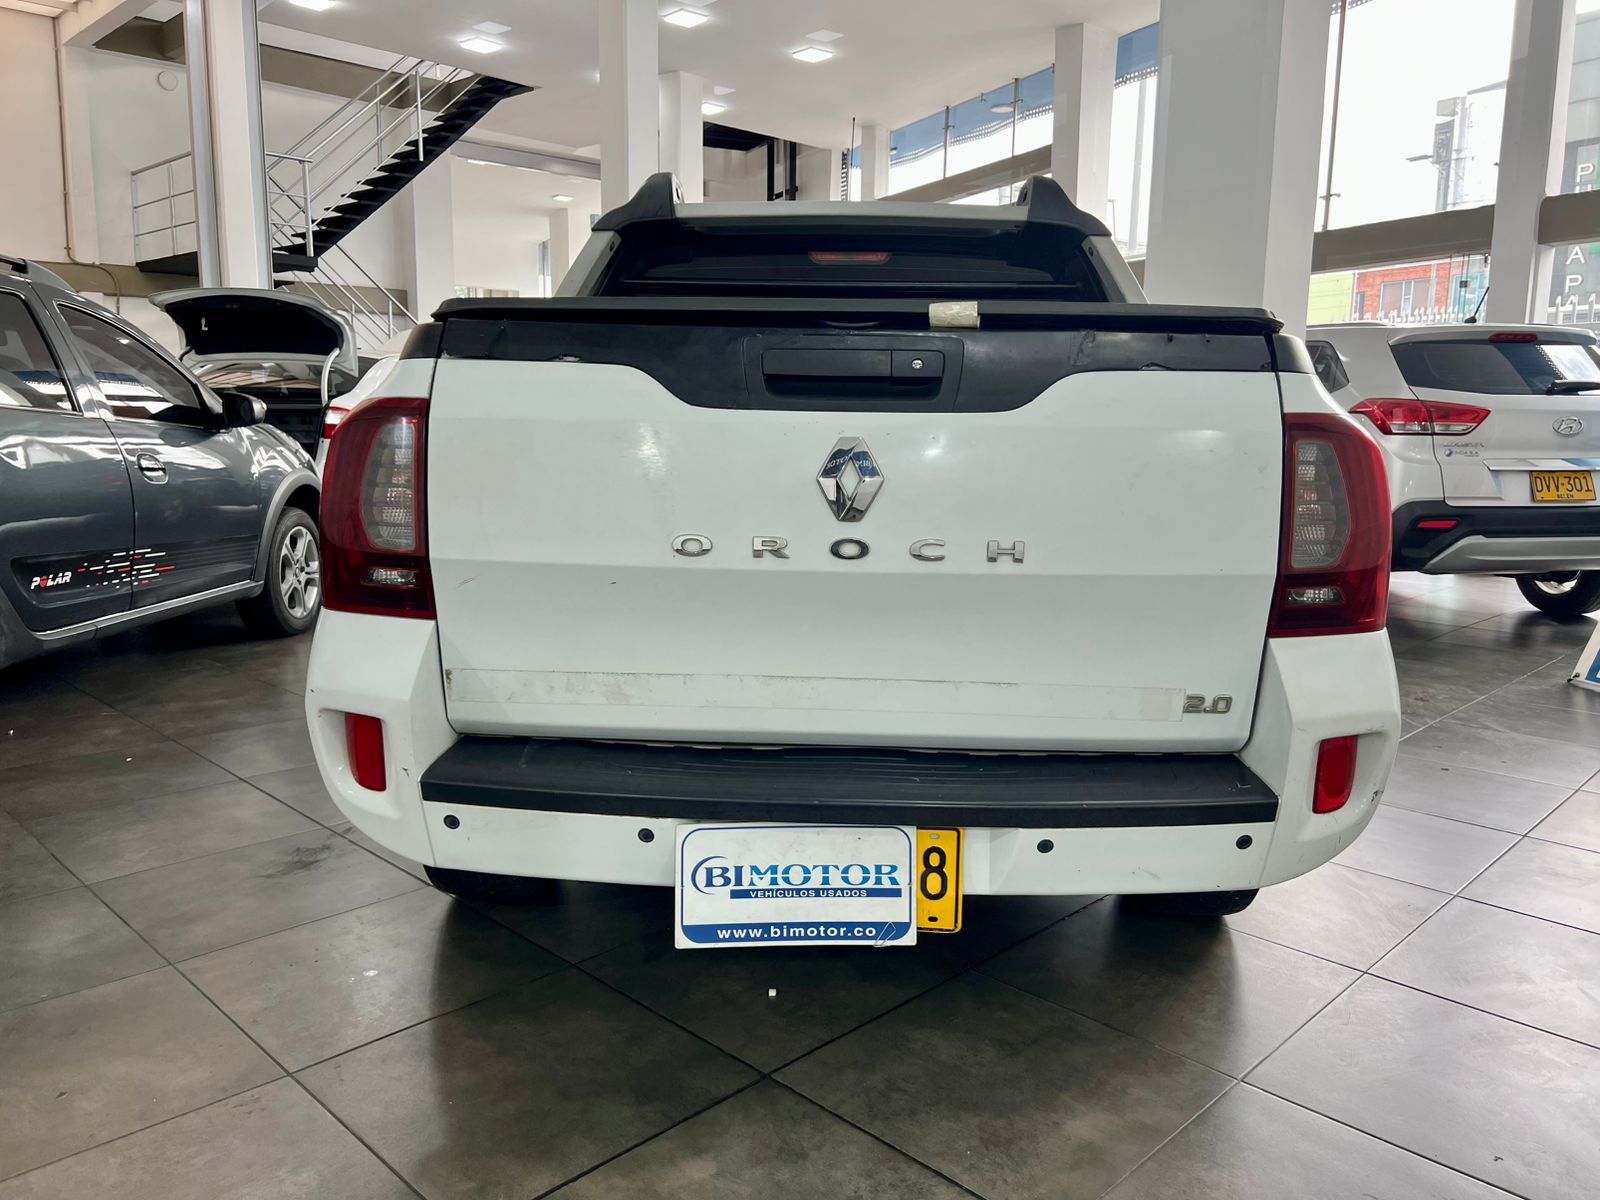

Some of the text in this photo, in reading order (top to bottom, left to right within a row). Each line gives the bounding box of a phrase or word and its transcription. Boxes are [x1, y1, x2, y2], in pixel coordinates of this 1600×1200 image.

[671, 533, 1025, 563] OROCH
[30, 571, 72, 590] POLAR
[1183, 694, 1233, 714] 2.0
[703, 863, 901, 888] BIMOTOR
[749, 888, 867, 898] VEHÍCULOS USADOS
[717, 925, 877, 939] www.bimotor.co
